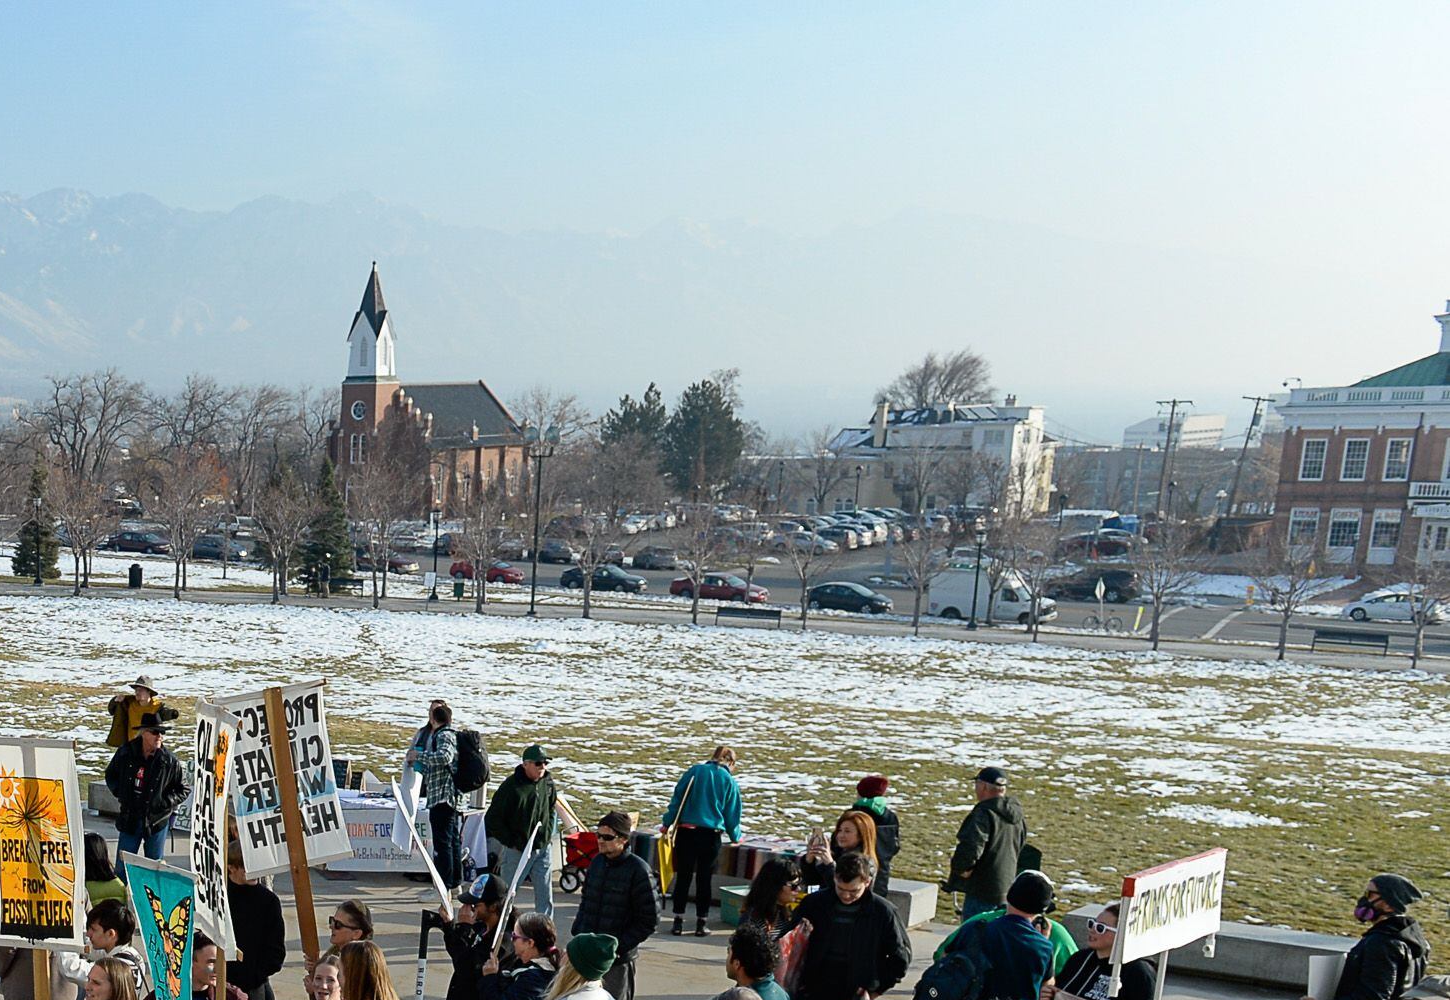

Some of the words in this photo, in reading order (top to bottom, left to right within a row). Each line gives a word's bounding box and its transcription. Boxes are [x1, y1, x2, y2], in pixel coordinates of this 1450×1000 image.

[2, 838, 30, 863] BREAK
[40, 841, 70, 864] FREE
[23, 878, 47, 894] FROM
[3, 899, 35, 926] FOSSIL
[37, 900, 72, 927] FUELS
